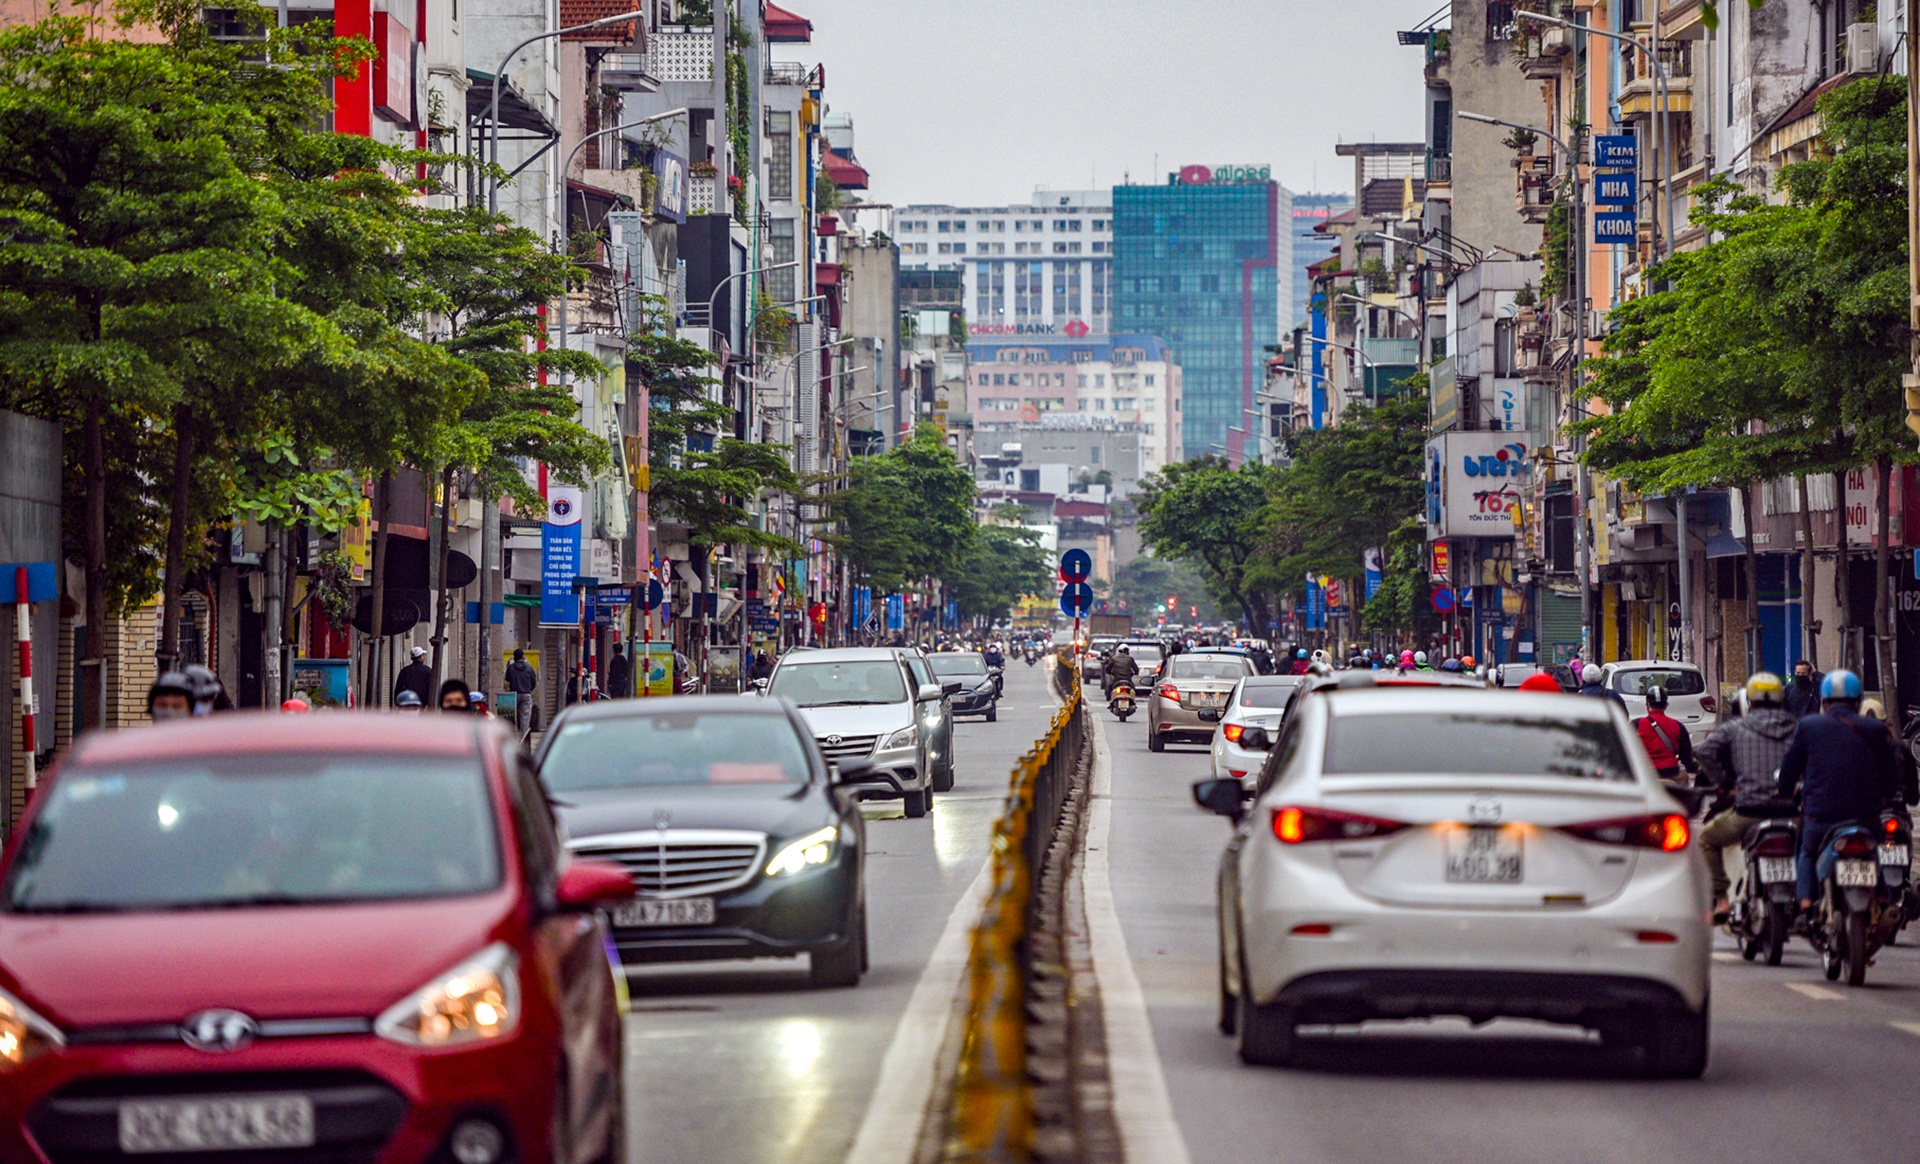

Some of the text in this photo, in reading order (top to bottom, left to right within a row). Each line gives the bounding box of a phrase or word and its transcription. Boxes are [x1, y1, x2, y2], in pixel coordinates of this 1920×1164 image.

[1608, 147, 1634, 156] KIM
[1601, 181, 1630, 197] NHA
[1597, 220, 1634, 236] KHOA
[966, 323, 1055, 335] CHCOMBANK
[1846, 502, 1867, 529] NỘI
